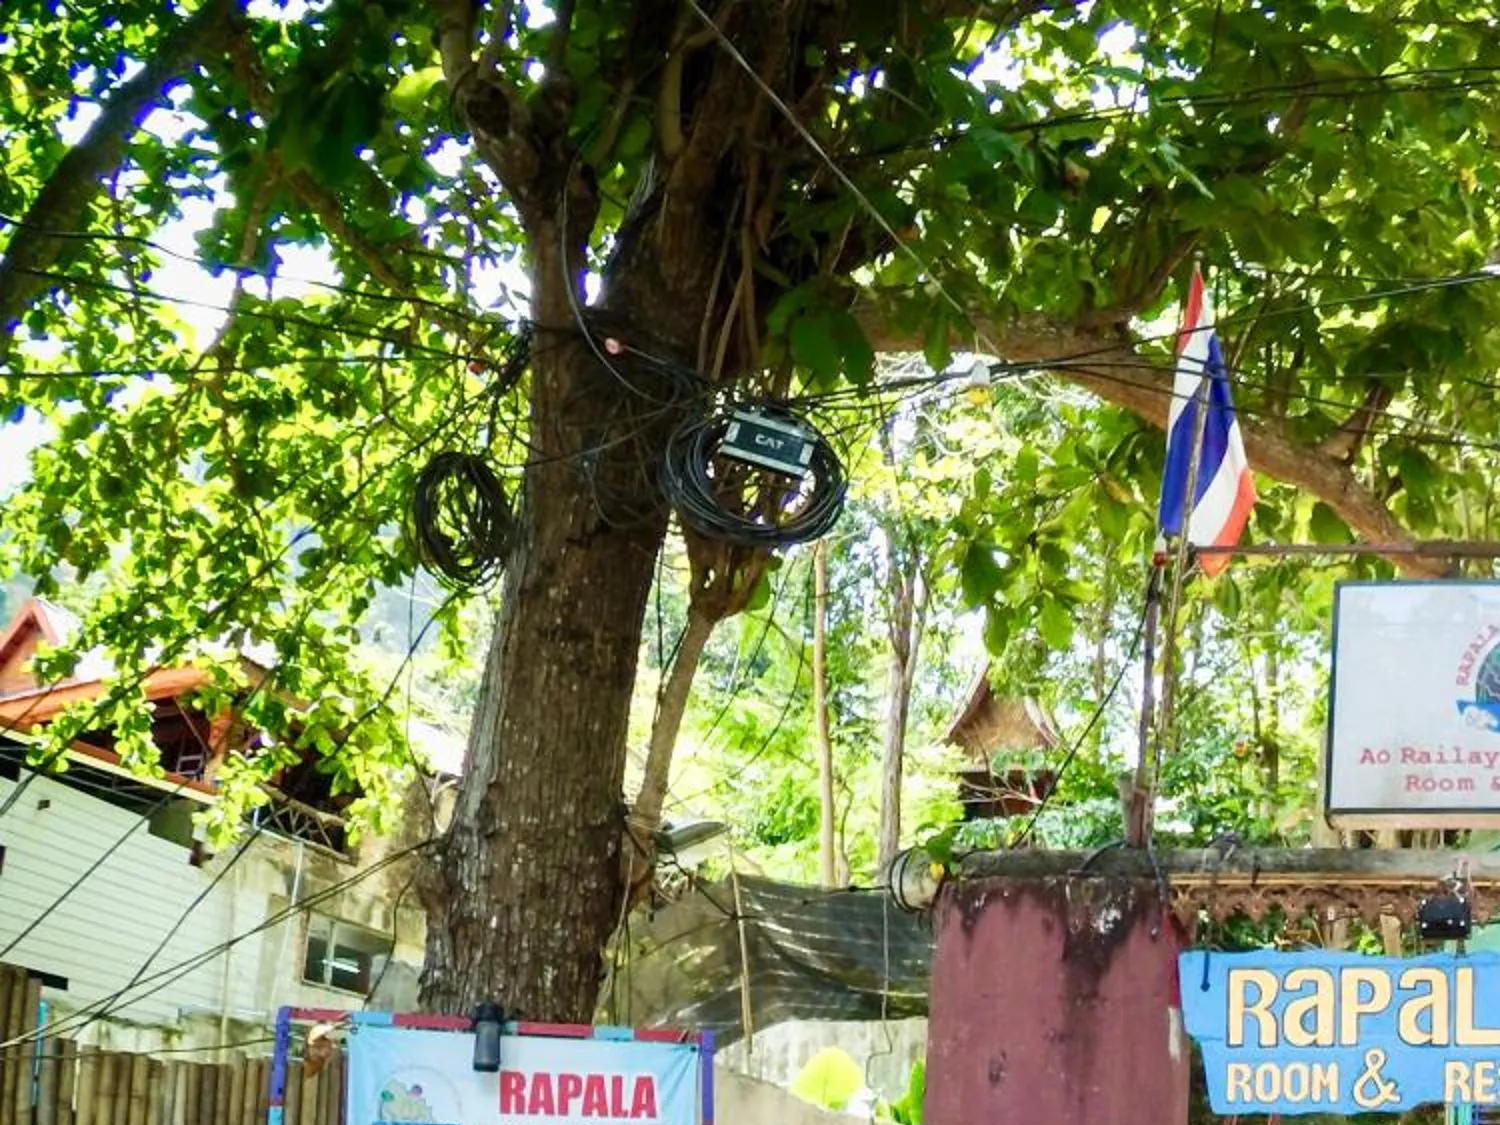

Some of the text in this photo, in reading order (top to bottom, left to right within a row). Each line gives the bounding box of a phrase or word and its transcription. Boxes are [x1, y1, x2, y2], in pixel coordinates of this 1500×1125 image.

[1455, 623, 1500, 686] RAPALA
[1360, 748, 1391, 766] Ao
[1401, 747, 1500, 769] Railay
[1405, 775, 1475, 793] Room
[499, 1070, 658, 1119] RAPALA
[1225, 1060, 1340, 1103] ROOM
[1352, 1047, 1401, 1109] &
